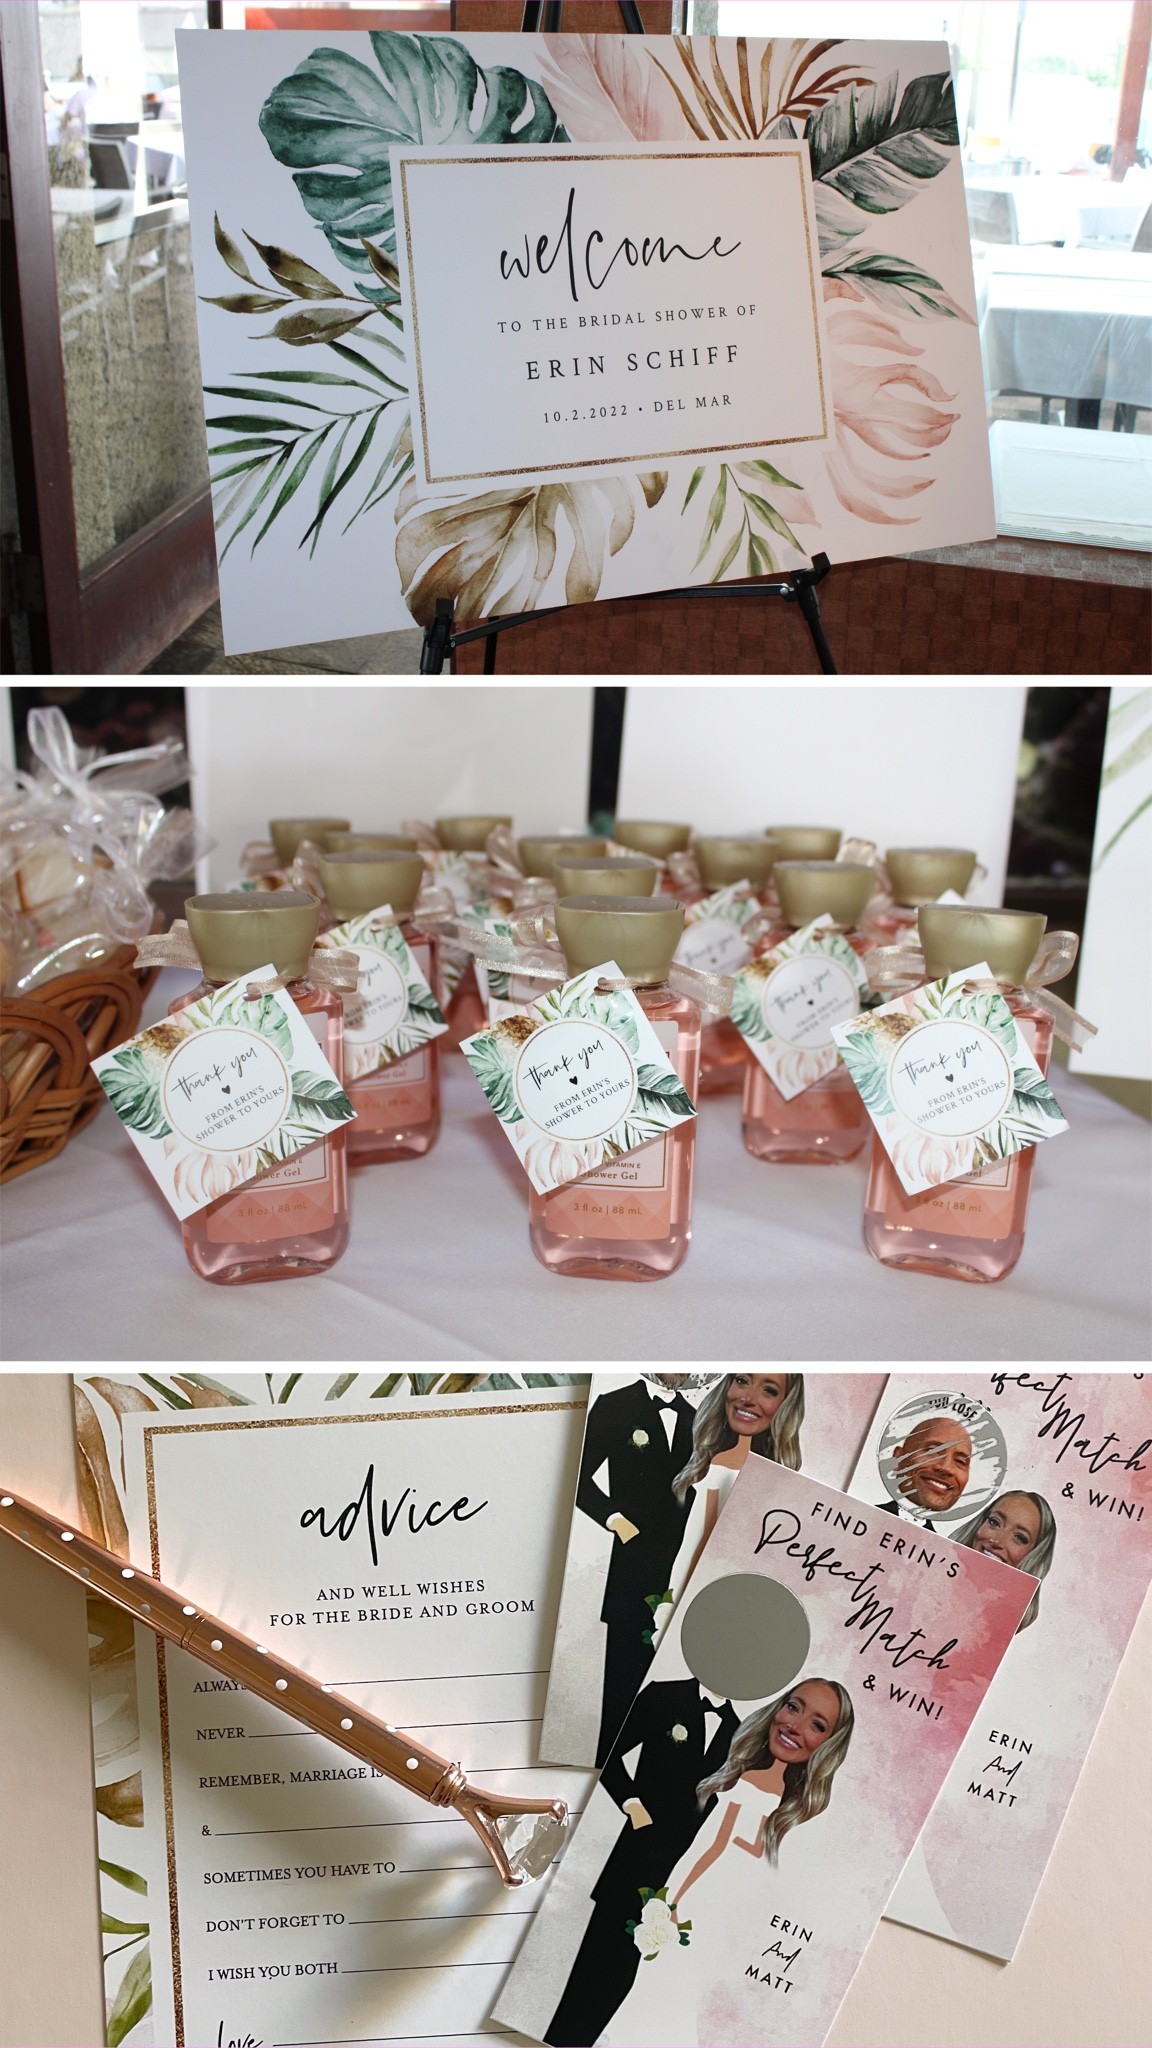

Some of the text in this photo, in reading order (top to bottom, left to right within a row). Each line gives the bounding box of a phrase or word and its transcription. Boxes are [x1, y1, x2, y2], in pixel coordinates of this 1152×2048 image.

[500, 187, 742, 302] welcome
[497, 304, 758, 334] TO THE BRIDAL SHOWER OF
[525, 343, 740, 381] ERIN SCHIFF
[542, 394, 733, 424] 10.2.2022 DEL MAR
[171, 1047, 257, 1102] thank you
[522, 1039, 604, 1091] thank you
[898, 1041, 982, 1086] thank you
[205, 1085, 265, 1124] FROM ERIN'S
[544, 1079, 631, 1129] SHOWER TO YOURS
[553, 1077, 611, 1112] FROM ERIN'S
[917, 1080, 1007, 1124] SHOWER TO YOURS
[927, 1077, 987, 1107] FROM ERIN'S
[196, 1086, 285, 1142] SHOWER TO YOURS
[284, 1167, 301, 1177] Gel
[621, 1171, 638, 1180] Gel
[573, 1203, 579, 1211] 3
[582, 1203, 588, 1212] fl
[612, 1205, 625, 1214] 88
[628, 1207, 643, 1215] mL
[953, 1201, 965, 1211] 88
[952, 1402, 978, 1422] LOSE
[1037, 1401, 1152, 1474] Match
[300, 1464, 489, 1566] advice
[1061, 1482, 1145, 1522] & WIN!
[754, 1509, 885, 1602] Perfect
[811, 1502, 961, 1578] FIND ERIN'S
[316, 1579, 487, 1601] AND WELL WISHES
[269, 1599, 536, 1627] FOR THE BRIDE AND GROOM
[844, 1590, 959, 1670] Match
[863, 1674, 945, 1721] & WIN!
[196, 1727, 246, 1741] NEVER
[988, 1729, 1034, 1756] ERIN
[198, 1773, 285, 1789] REMEMBER,
[290, 1768, 367, 1783] MARRIAGE
[982, 1755, 1023, 1787] And
[966, 1781, 1018, 1808] MATT
[201, 1825, 213, 1837] &
[203, 1861, 396, 1885] SOMETIMES YOU HAVE TO
[206, 1912, 345, 1933] DON'T FORGET TO
[769, 1914, 814, 1943] ERIN
[208, 1962, 338, 1981] I WISH YOU BOTH
[761, 1940, 802, 1972] And
[745, 1963, 794, 1994] MATT
